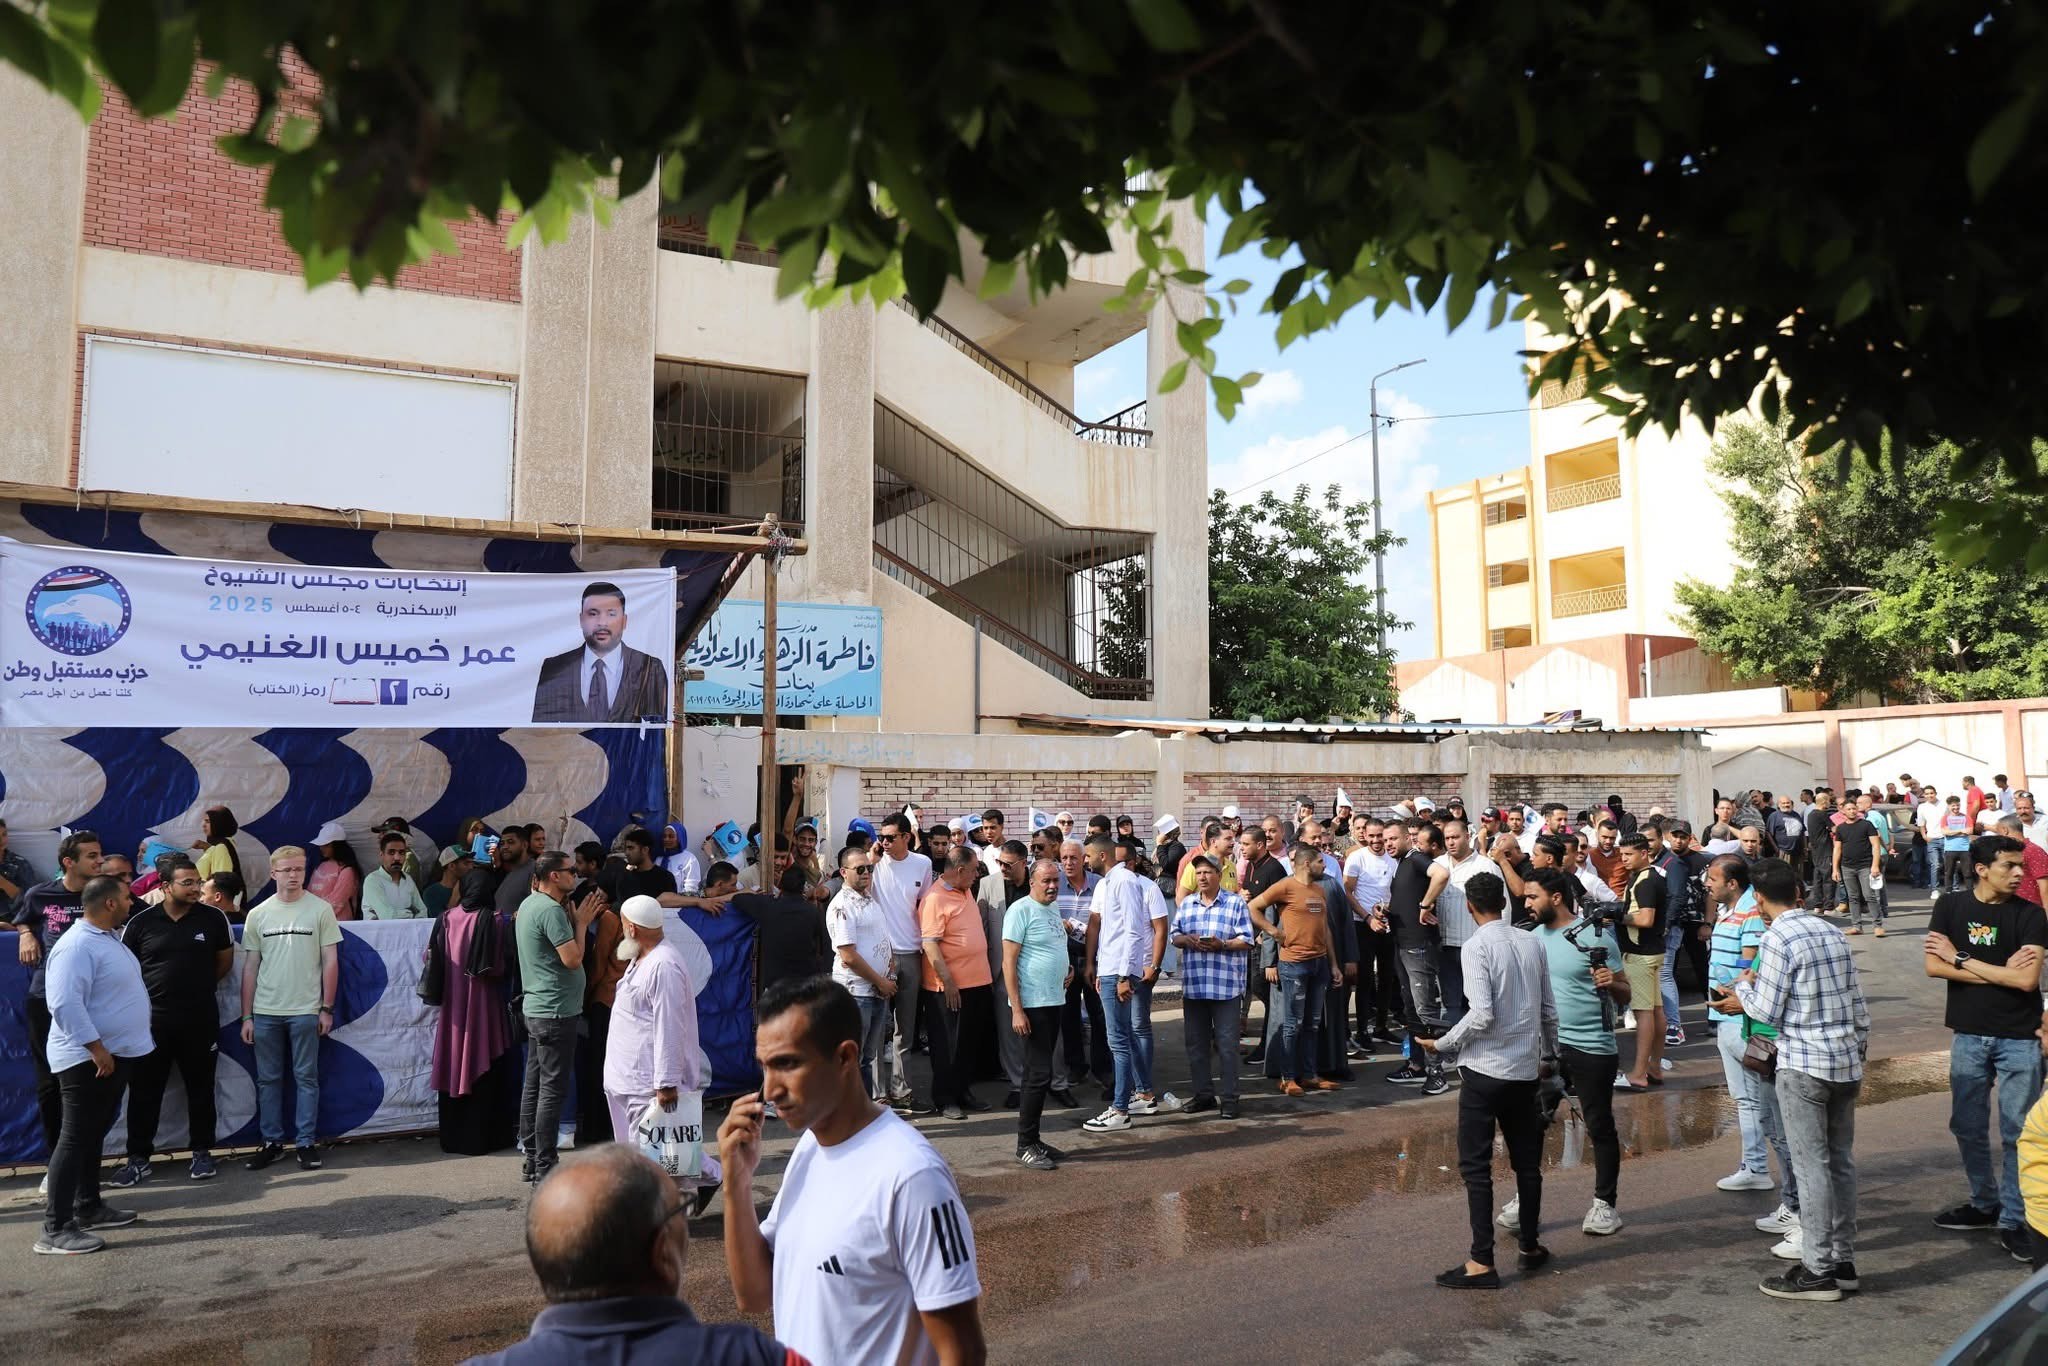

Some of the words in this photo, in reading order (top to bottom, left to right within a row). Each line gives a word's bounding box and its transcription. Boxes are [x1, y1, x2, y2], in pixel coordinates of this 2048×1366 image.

[204, 566, 286, 587] الشيوخ
[291, 574, 369, 591] مجلس
[375, 577, 467, 596] إنتخابات
[208, 595, 273, 613] 2025
[284, 600, 340, 614] أغسطس
[180, 633, 327, 669] الغنيمي
[336, 638, 450, 665] خميس
[459, 645, 516, 667] عمر
[816, 634, 876, 671] فاطمة
[3, 659, 41, 681] وطن
[44, 660, 113, 682] مستقبل
[116, 663, 149, 683] حزب
[20, 689, 43, 699] مصر
[70, 689, 85, 699] من
[248, 682, 300, 697] (الكتاب)
[301, 684, 326, 697] رمز
[412, 683, 450, 699] رقم
[835, 696, 872, 709] الحاصلة
